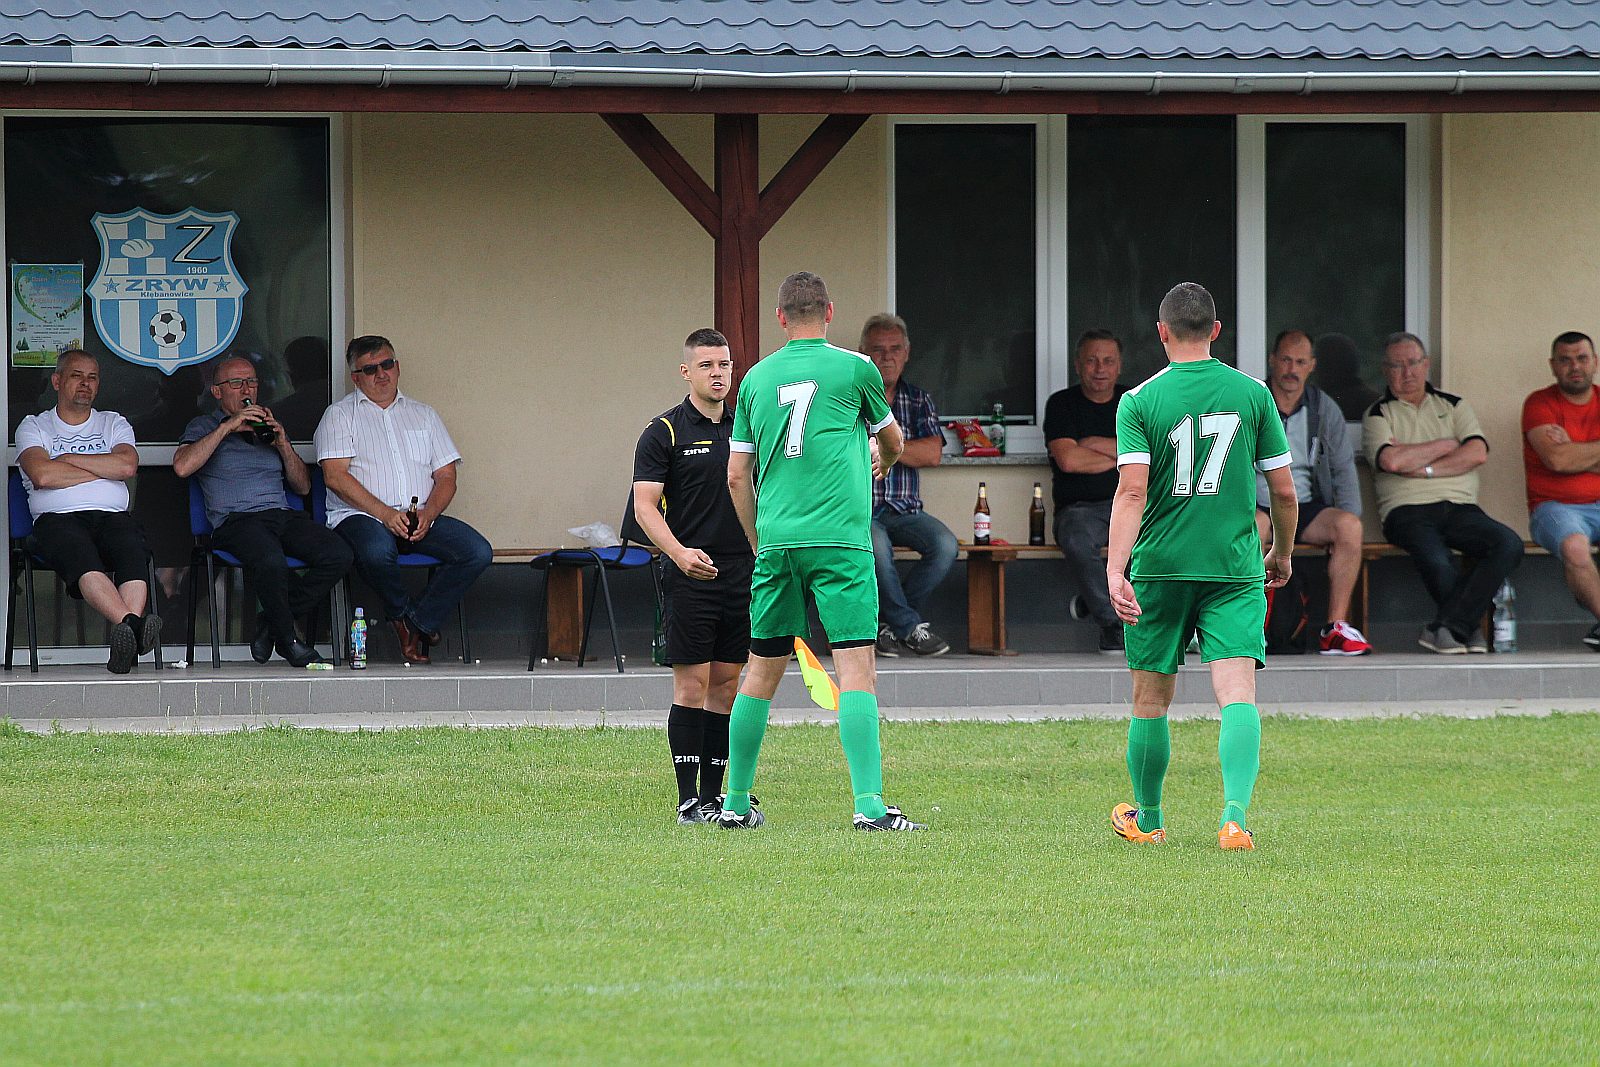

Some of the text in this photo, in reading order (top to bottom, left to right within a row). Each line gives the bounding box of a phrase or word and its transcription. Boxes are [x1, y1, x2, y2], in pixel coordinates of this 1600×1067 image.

[125, 278, 209, 291] ZRYW
[186, 266, 209, 274] 1960
[776, 379, 819, 459] 7
[1168, 411, 1242, 496] 17
